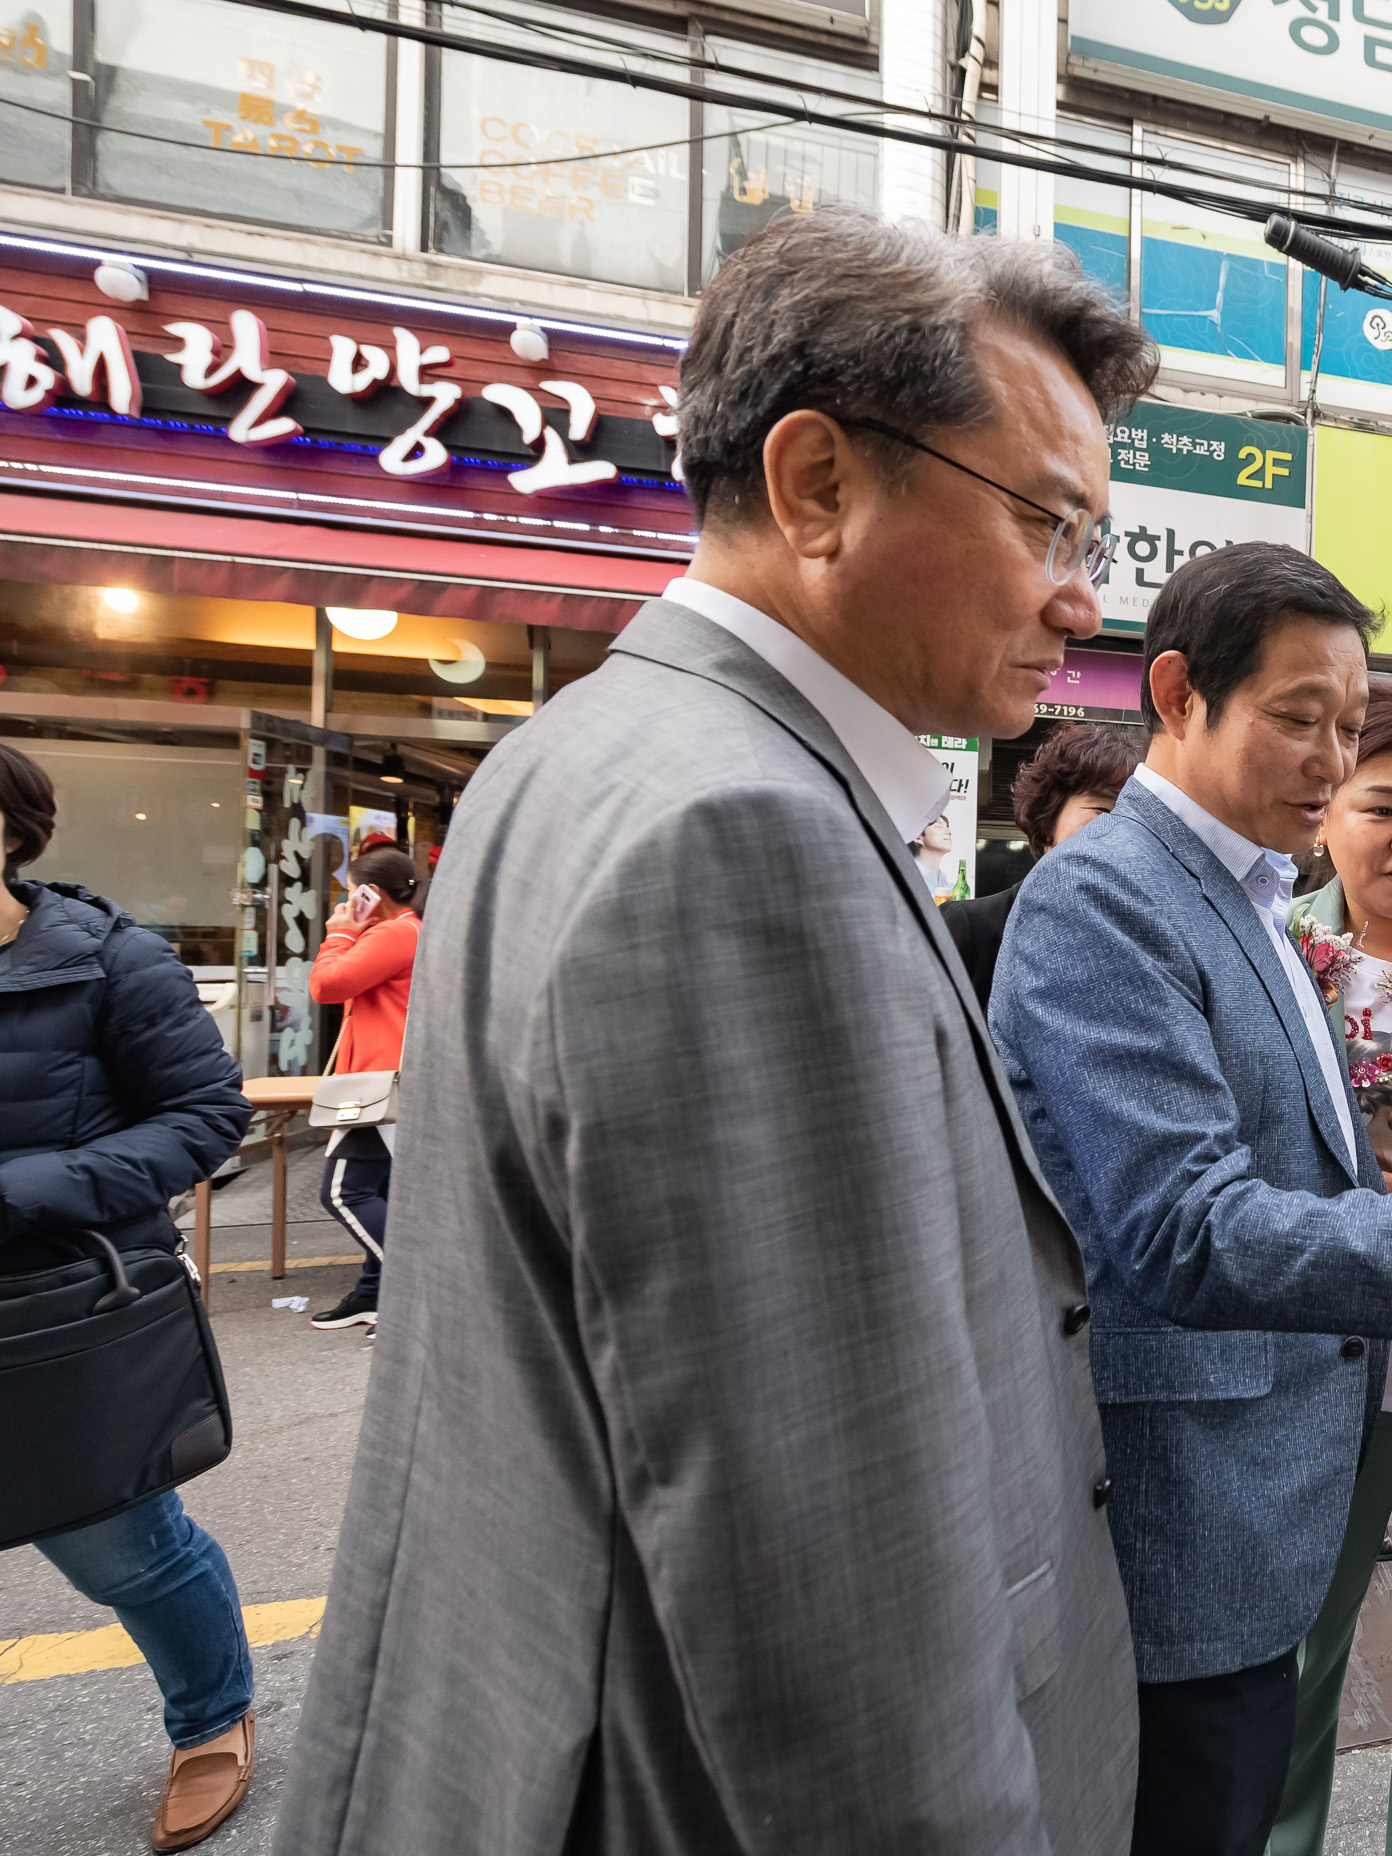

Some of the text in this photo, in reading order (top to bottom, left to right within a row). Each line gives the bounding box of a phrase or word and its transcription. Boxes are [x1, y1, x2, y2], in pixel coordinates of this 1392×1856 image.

[202, 119, 365, 174] TAROT
[479, 116, 687, 181] COCKTAIL
[479, 149, 656, 207] COFFEE
[479, 179, 595, 223] BEER
[1117, 448, 1152, 472] 전문
[1160, 432, 1227, 461] 척추교정
[1236, 445, 1293, 490] 2F
